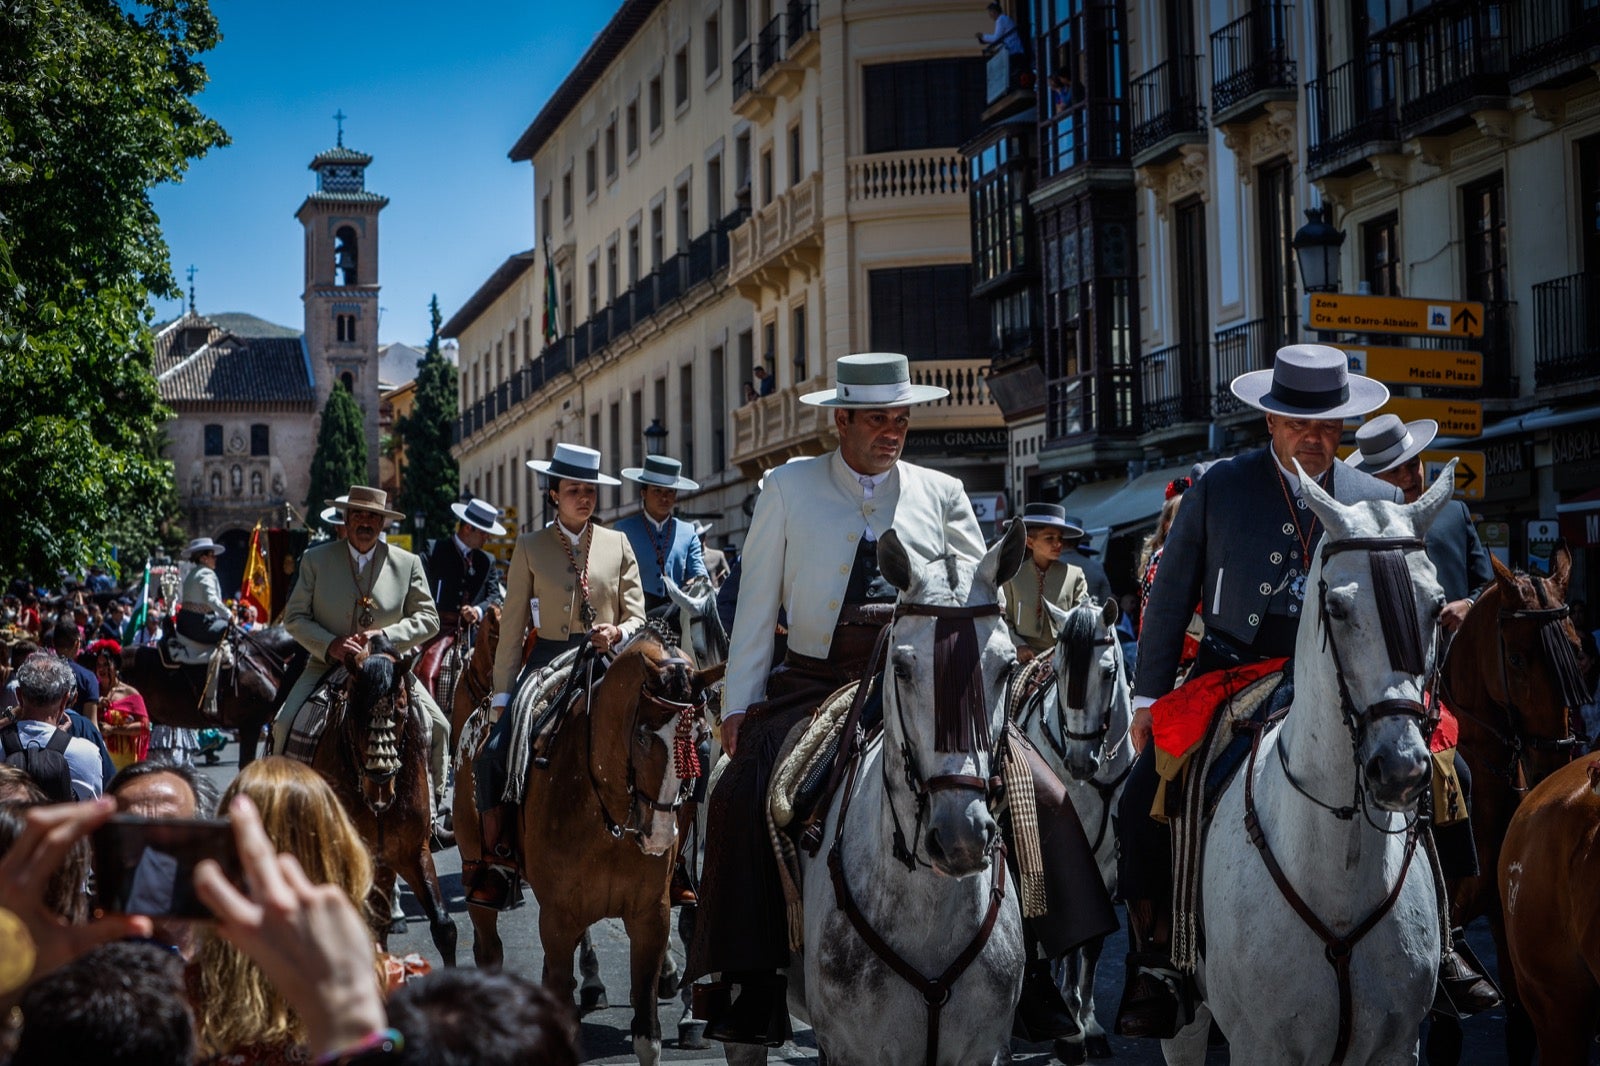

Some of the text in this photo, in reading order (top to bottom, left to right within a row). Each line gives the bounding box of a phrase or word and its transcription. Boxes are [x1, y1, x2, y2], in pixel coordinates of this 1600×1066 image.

[1315, 299, 1338, 309] Zona
[1315, 314, 1334, 323] Cra.
[1338, 316, 1352, 324] del
[1456, 357, 1476, 365] Hotel
[1445, 369, 1476, 381] Plaza
[1440, 418, 1476, 431] ntares
[944, 431, 1008, 446] GRANAD
[1553, 430, 1591, 463] SABOR
[1487, 440, 1522, 476] SPAÑA
